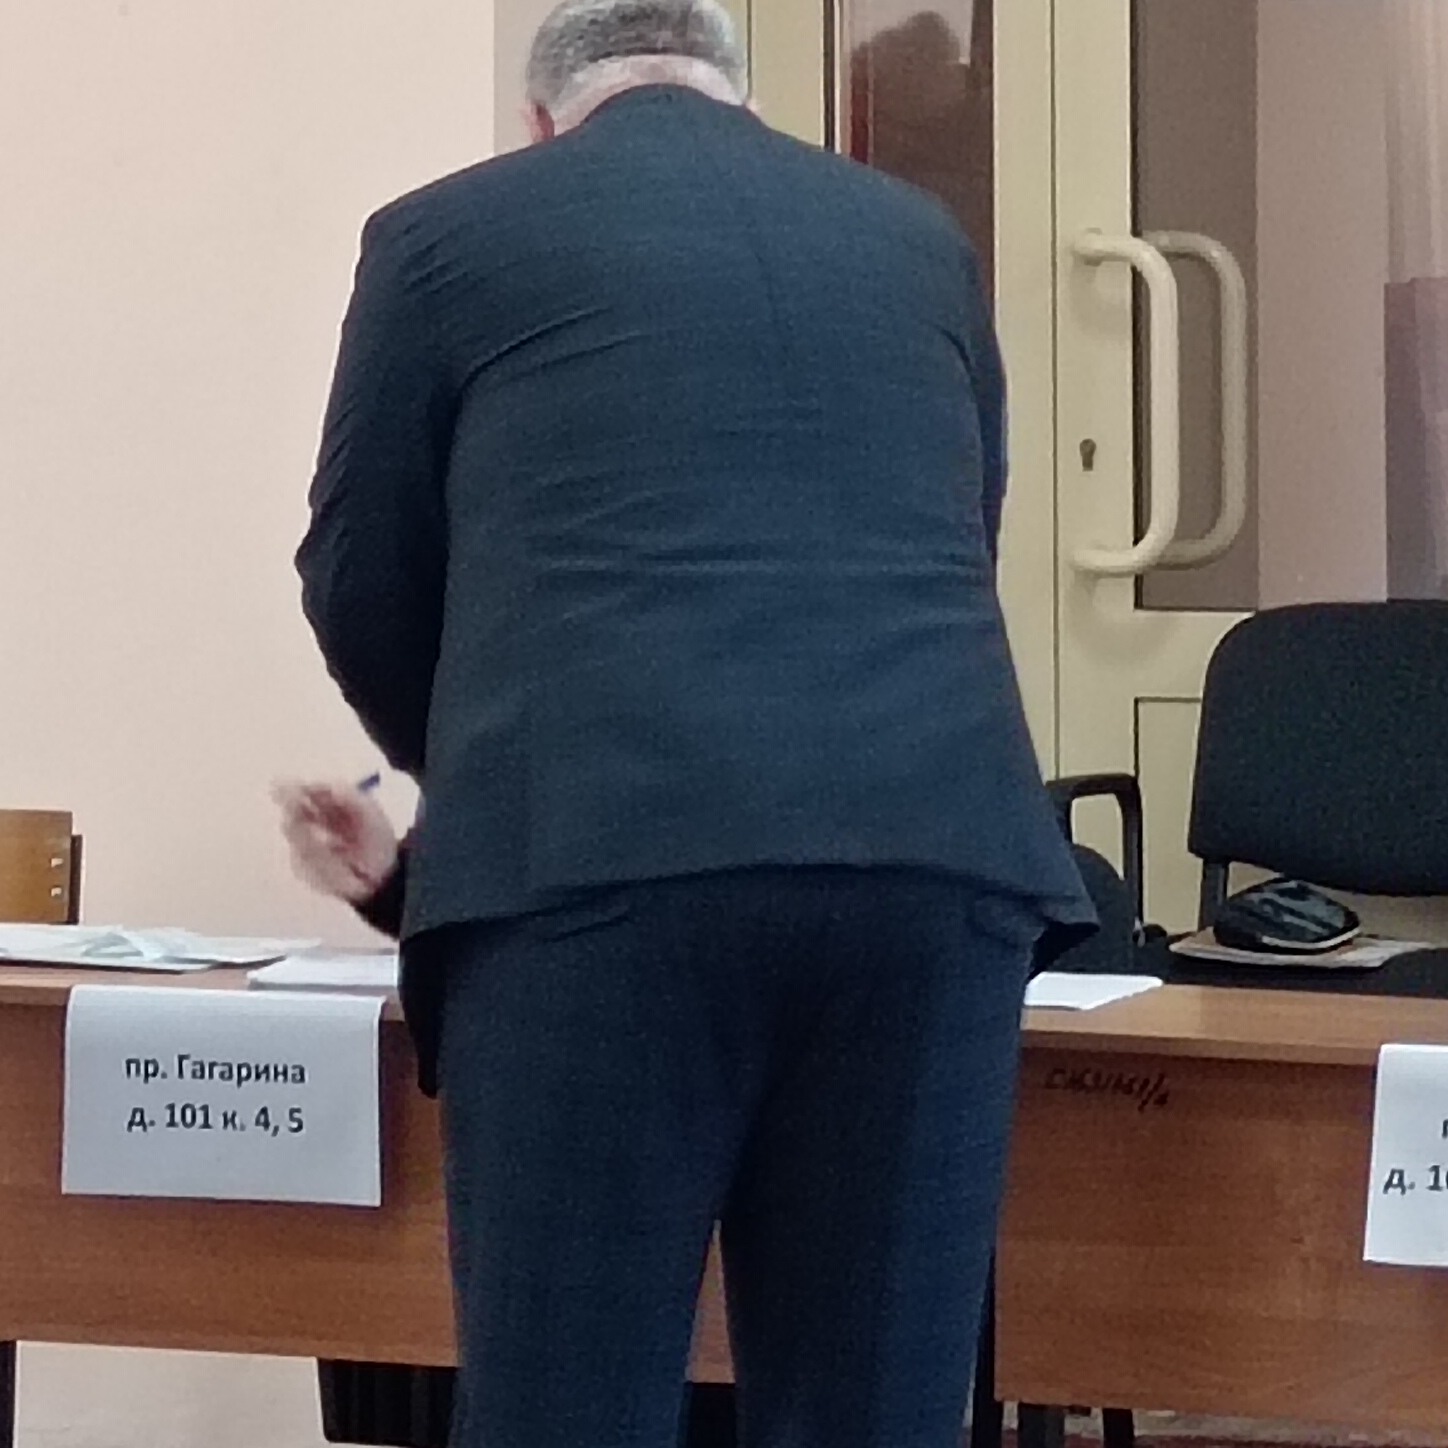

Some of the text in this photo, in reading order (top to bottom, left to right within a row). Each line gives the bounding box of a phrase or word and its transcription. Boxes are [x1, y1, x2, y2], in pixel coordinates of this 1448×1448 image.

[125, 1053, 306, 1089] пр. Гагарина
[126, 1102, 304, 1138] д. 101 к. 4, 5
[1382, 1167, 1416, 1197] д.
